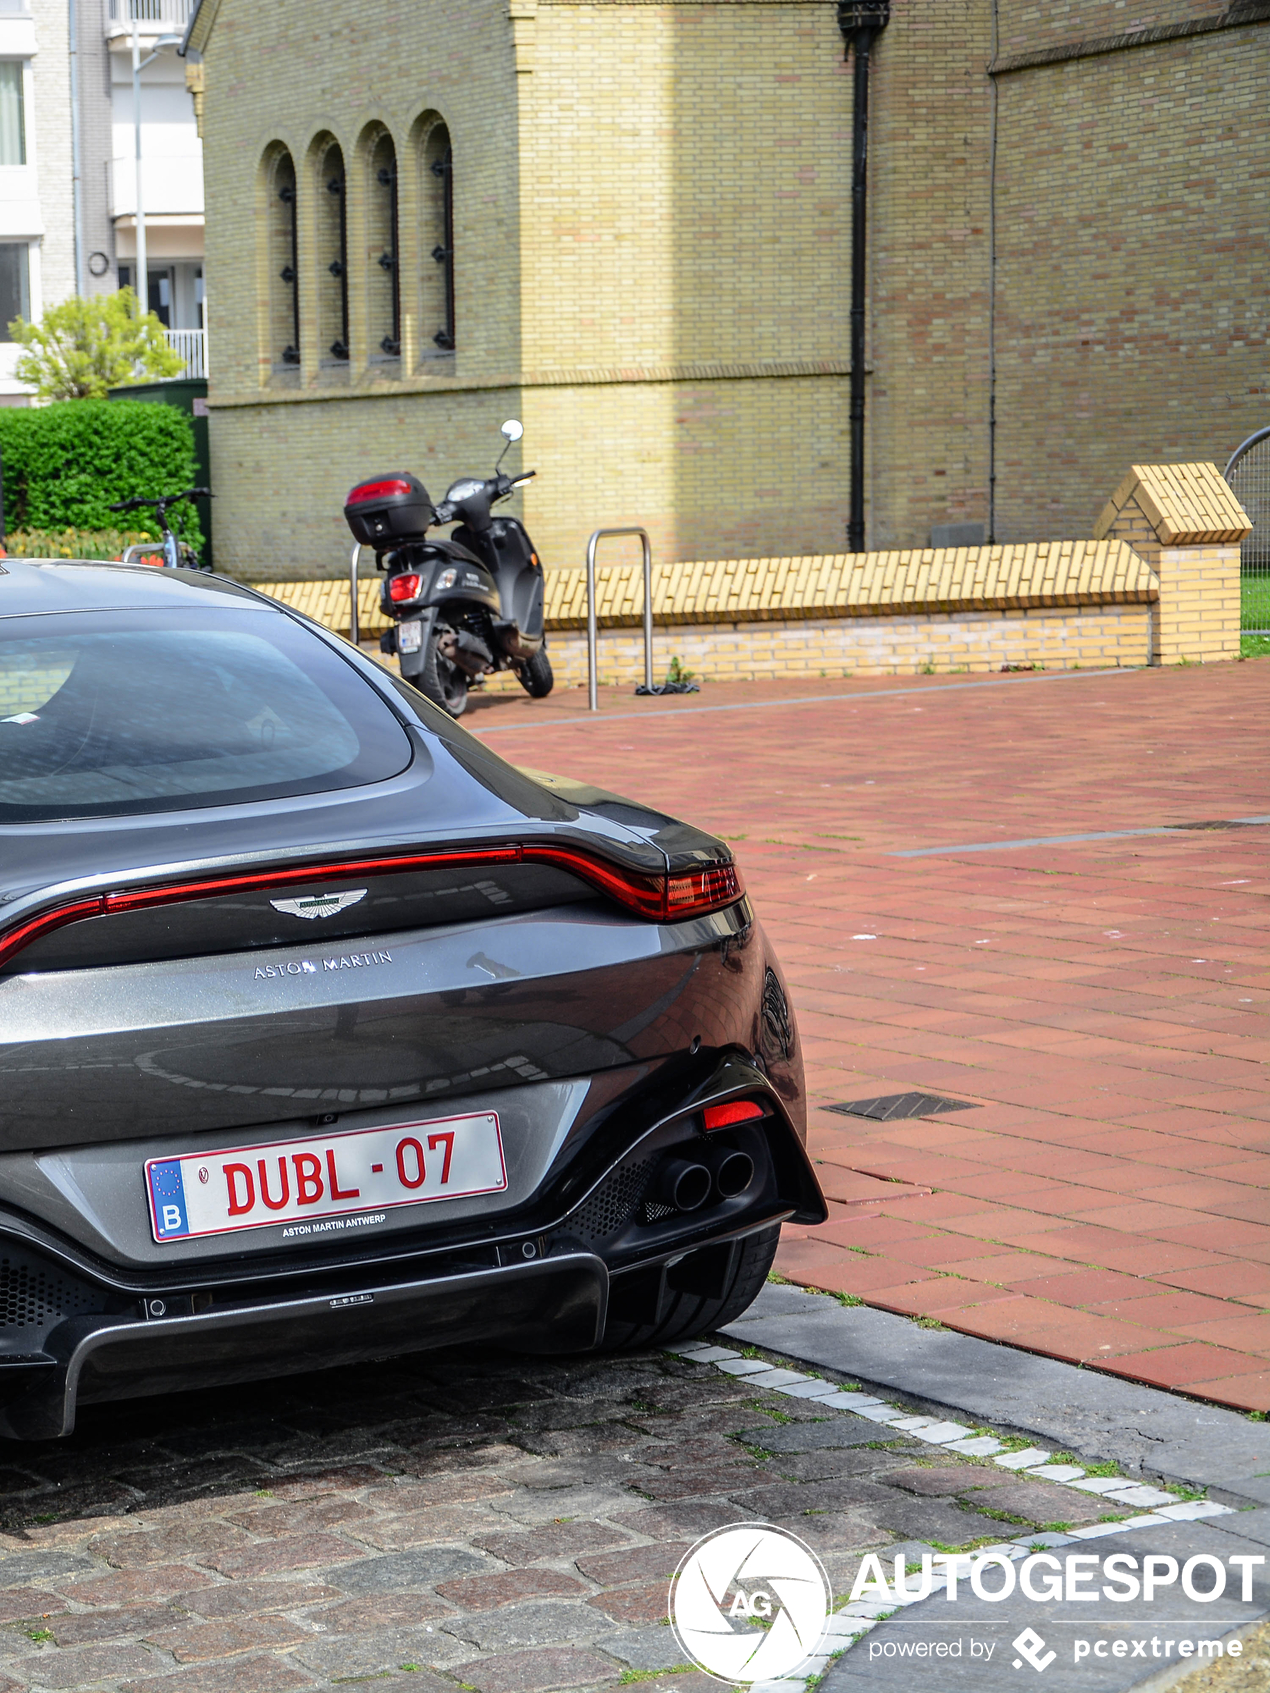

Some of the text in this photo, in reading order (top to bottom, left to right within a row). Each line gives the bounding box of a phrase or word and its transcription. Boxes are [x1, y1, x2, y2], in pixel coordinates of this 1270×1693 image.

[254, 951, 392, 980] ASTON MARTIN
[162, 1205, 181, 1230] B
[282, 1213, 387, 1238] ASTON MARTIN ANTWERP
